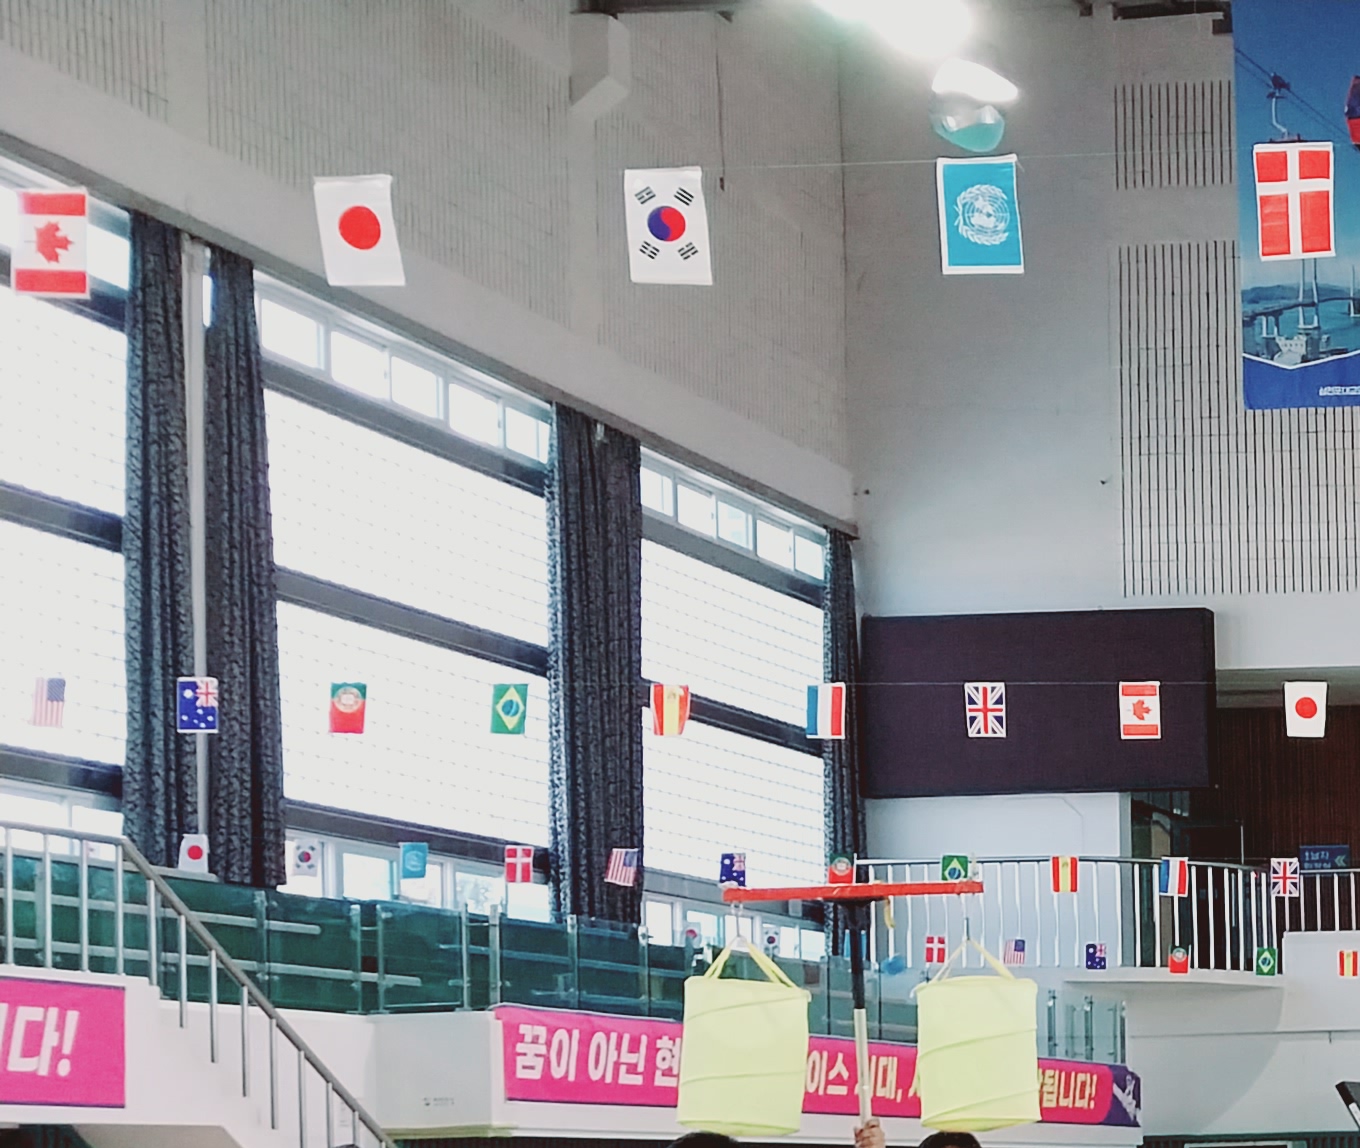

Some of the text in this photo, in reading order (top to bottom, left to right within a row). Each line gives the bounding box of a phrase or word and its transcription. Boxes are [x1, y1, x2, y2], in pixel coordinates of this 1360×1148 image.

[0, 1003, 80, 1077] 다!
[515, 1023, 580, 1082] 꿈이
[588, 1031, 648, 1086] 아닌
[1038, 1067, 1098, 1109] 됩니다!
